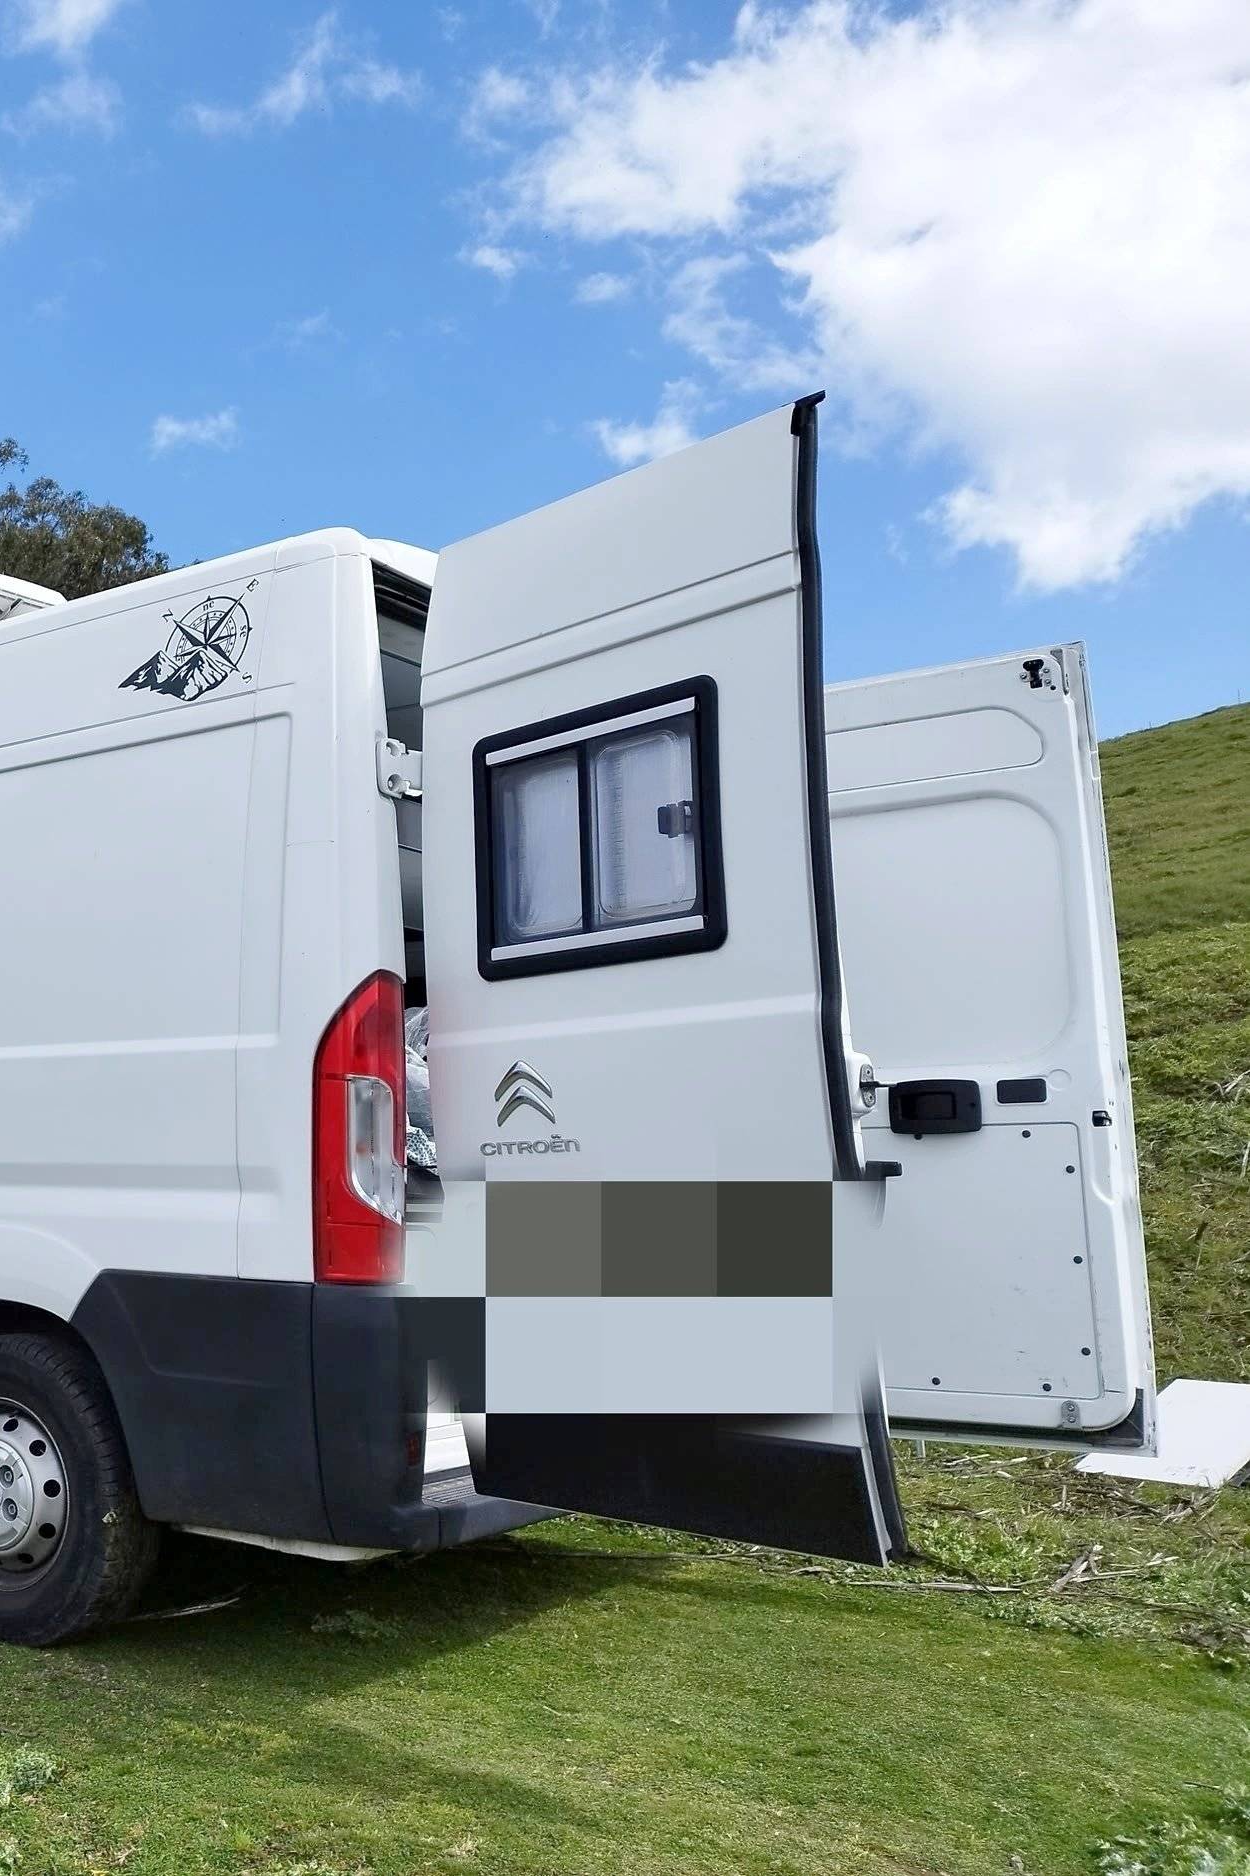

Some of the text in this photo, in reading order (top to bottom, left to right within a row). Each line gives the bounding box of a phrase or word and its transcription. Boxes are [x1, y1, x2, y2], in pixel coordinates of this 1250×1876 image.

[246, 579, 259, 592] E
[162, 609, 173, 622] N
[242, 672, 253, 684] S
